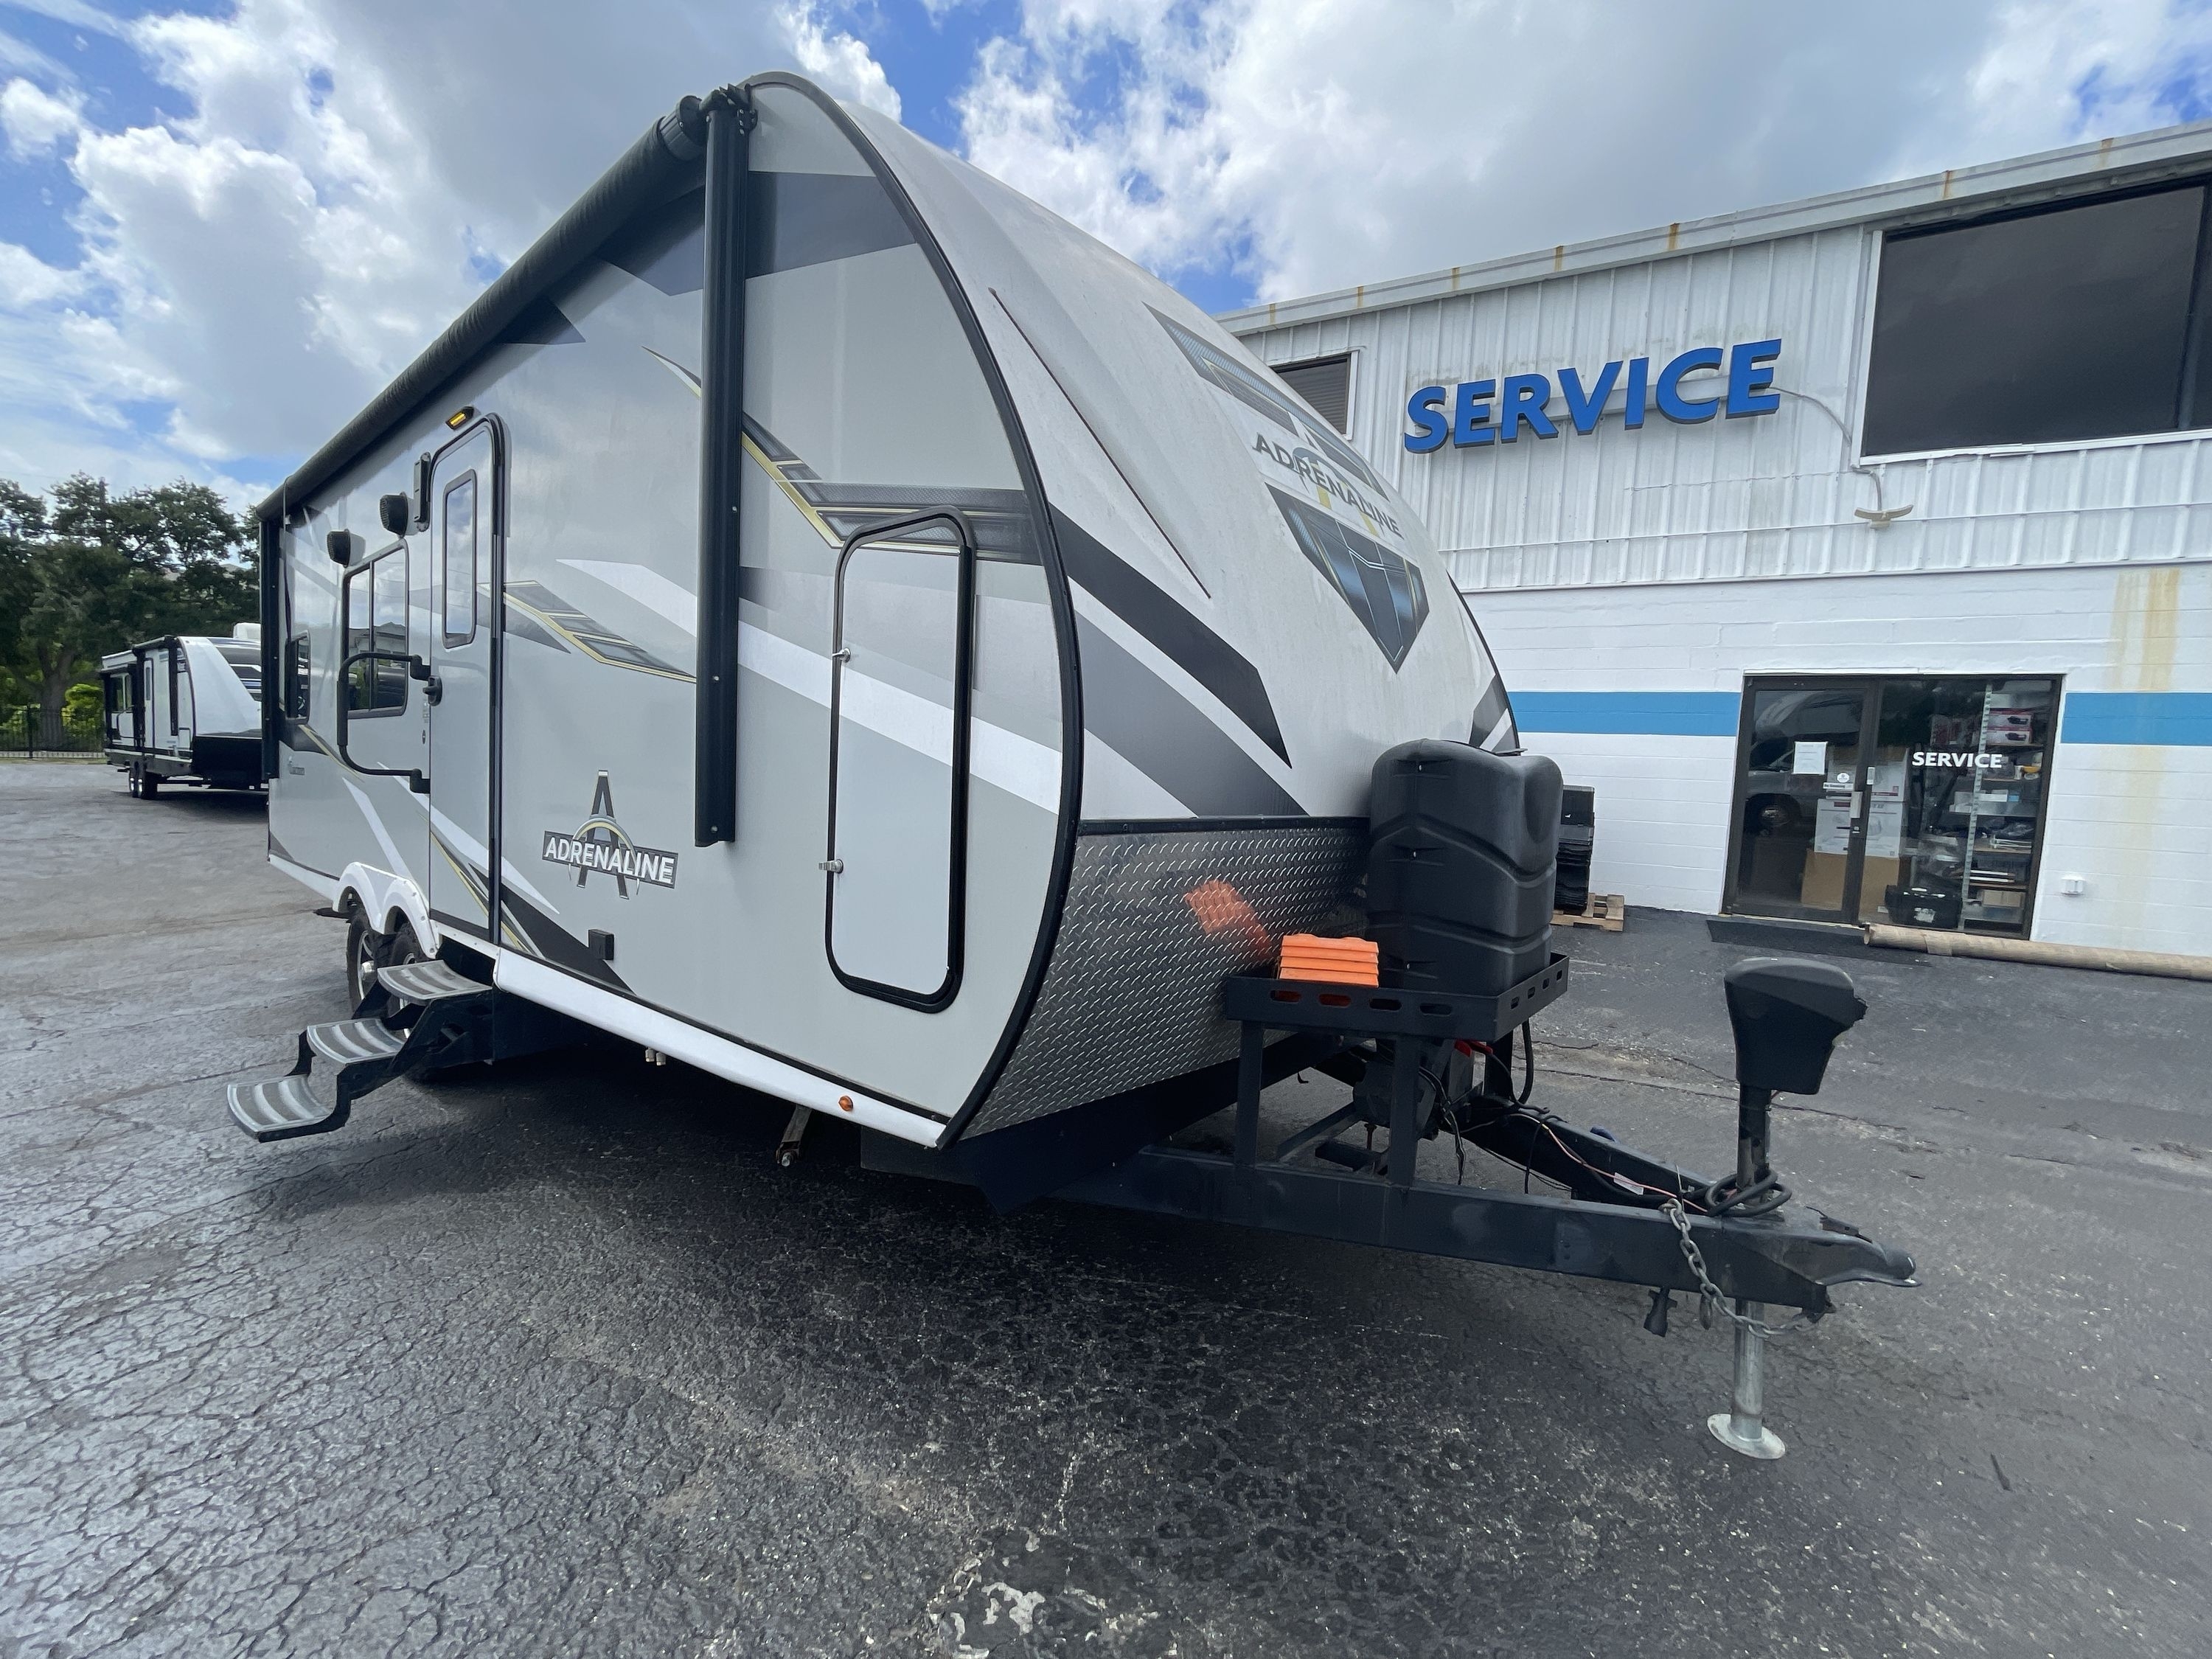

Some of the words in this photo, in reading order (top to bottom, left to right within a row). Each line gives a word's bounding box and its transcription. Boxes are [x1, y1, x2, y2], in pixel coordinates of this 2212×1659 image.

[1404, 339, 1781, 454] SERVICE
[1252, 432, 1405, 540] ADRENALINE
[1912, 751, 2003, 768] SERVICE
[544, 837, 675, 883] ADRENALINE
